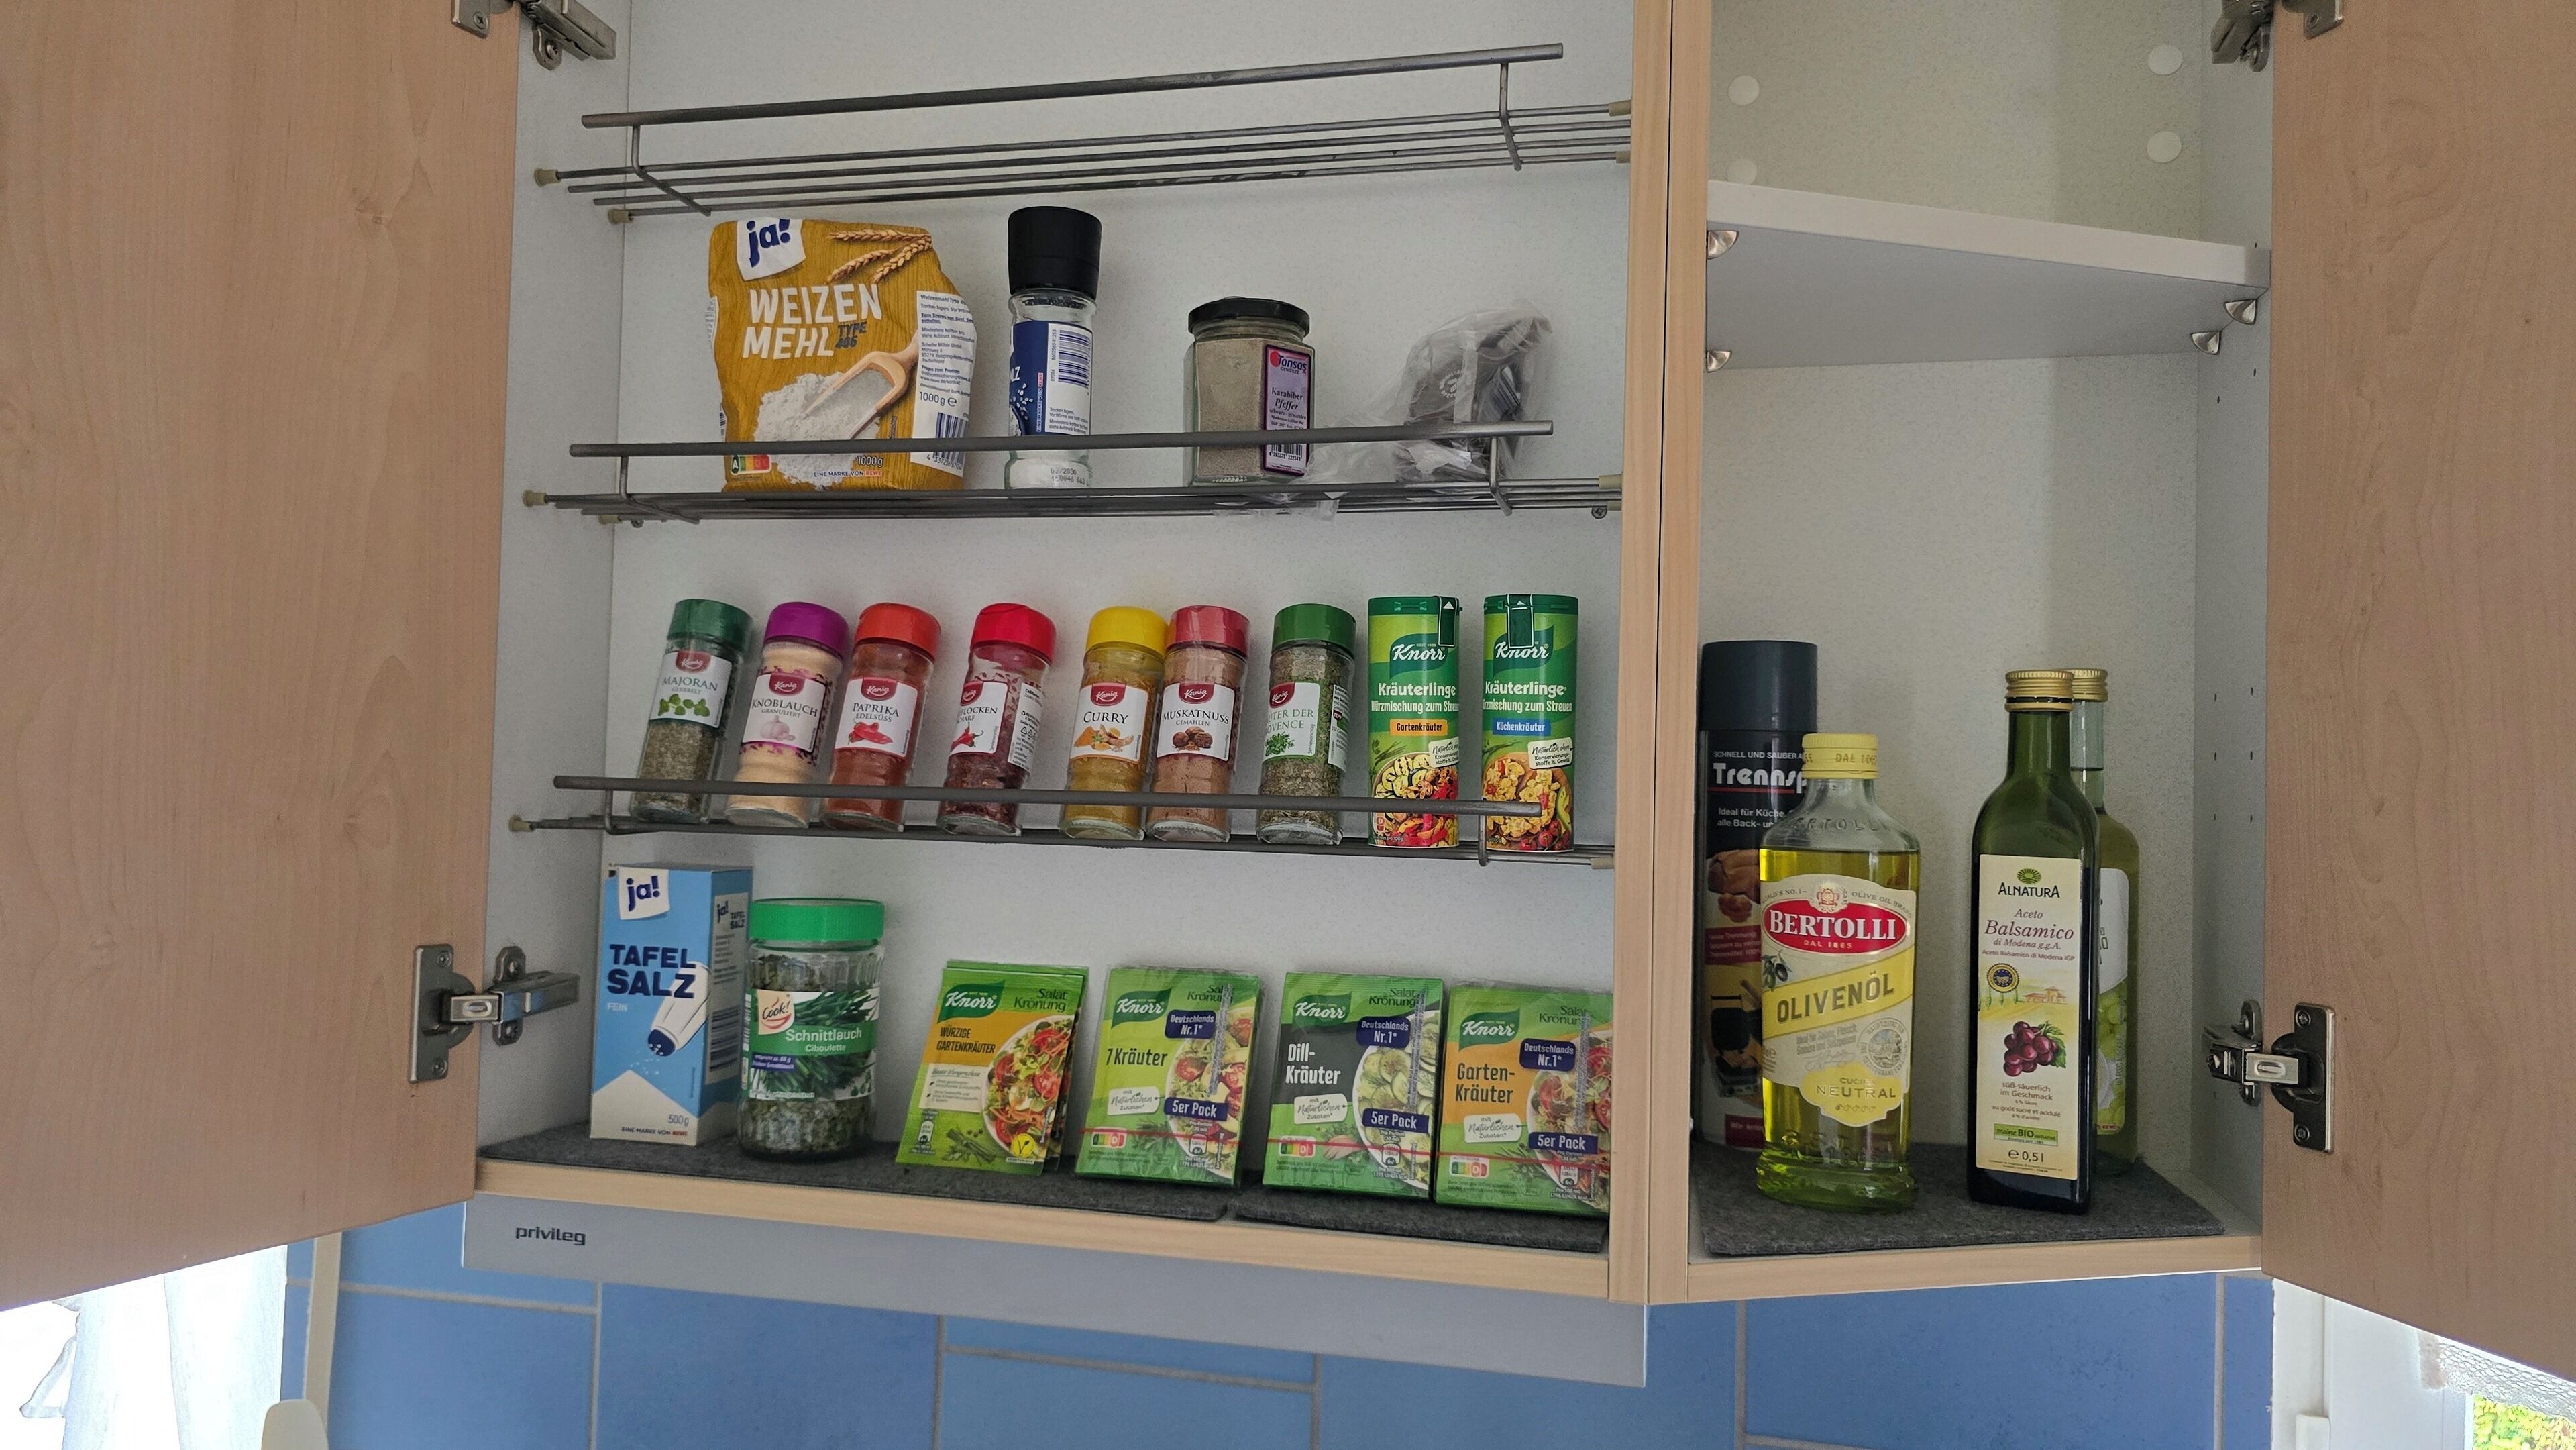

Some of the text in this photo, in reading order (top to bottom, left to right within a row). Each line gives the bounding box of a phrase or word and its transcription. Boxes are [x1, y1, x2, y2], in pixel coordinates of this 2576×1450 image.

[747, 219, 790, 267] ja!
[749, 284, 882, 324] WEIZEN
[838, 321, 867, 337] TYPE
[743, 327, 834, 360] MEHL
[1392, 643, 1446, 661] Knorr
[1495, 641, 1550, 659] Knorr
[1095, 690, 1118, 702] Kania
[1183, 688, 1208, 700] Kania
[1378, 682, 1456, 698] Kräuterlinge
[1485, 681, 1564, 698] Kräuterlinge
[751, 698, 818, 717] KNOBLAUCH
[853, 703, 900, 717] PAPRIKA
[1426, 702, 1442, 712] zum
[1482, 698, 1573, 713] ürzmischung zum Streuen
[761, 709, 801, 719] GRANULIERT
[855, 713, 892, 723] EDELSÜSS
[1083, 711, 1128, 724] CURRY
[1162, 709, 1229, 725] MUSKATNUSS
[1267, 709, 1314, 723] UTER DER
[1266, 720, 1305, 735] OVENCE
[1397, 723, 1443, 731] Gartenkräuter
[1497, 721, 1545, 732] Küchenkräuter
[1719, 807, 1784, 817] Ideal für Küche
[1733, 819, 1760, 827] Back-
[626, 876, 660, 912] ja!
[1998, 882, 2060, 898] ALNATURA
[1851, 891, 1876, 900] OLIVE
[1879, 896, 1891, 905] OIL
[2014, 909, 2043, 919] Aceto
[1770, 909, 1896, 940] BERTOLLI
[1984, 919, 2074, 940] Balsamico
[2004, 939, 2036, 947] Modena
[610, 943, 696, 968] TAFEL
[608, 968, 696, 998] SALZ
[945, 991, 996, 1009] Knorr
[1037, 988, 1067, 1000] Salat
[1368, 995, 1417, 1008] Krönung
[1777, 970, 1894, 1023] OLIVENÖL
[608, 1002, 628, 1011] FEIN
[762, 1001, 790, 1020] Cook!
[1014, 997, 1067, 1013] Krönung
[1116, 998, 1164, 1014] Knorr
[1295, 1002, 1346, 1019] Knorr
[1170, 1014, 1214, 1023] Deutschlands
[1361, 1020, 1409, 1031] Deutschlands
[786, 1027, 862, 1041] Schnittlauch
[940, 1025, 971, 1039] WÜRZIGE
[1462, 1020, 1515, 1036] Knorr
[805, 1043, 846, 1053] Ciboulette
[936, 1040, 996, 1054] GARTENKRÄUTER
[1288, 1043, 1316, 1061] Dill-
[1524, 1043, 1574, 1054] Deutschlands
[1106, 1048, 1168, 1066] 7 Kräuter
[1285, 1065, 1341, 1085] Kräuter
[1457, 1062, 1515, 1081] Garten-
[1455, 1084, 1513, 1104] Kräuter
[1817, 1085, 1896, 1098] NEUTRAL
[2012, 1090, 2053, 1101] Geschmack
[1172, 1100, 1217, 1117] 5er Pack
[1371, 1111, 1417, 1129] 5er Pack
[1468, 1121, 1514, 1133] Natürlichen
[2018, 1129, 2034, 1138] BIO
[1537, 1134, 1586, 1151] 5er Pack
[2022, 1151, 2039, 1162] 0,5
[515, 1226, 586, 1246] privileg
